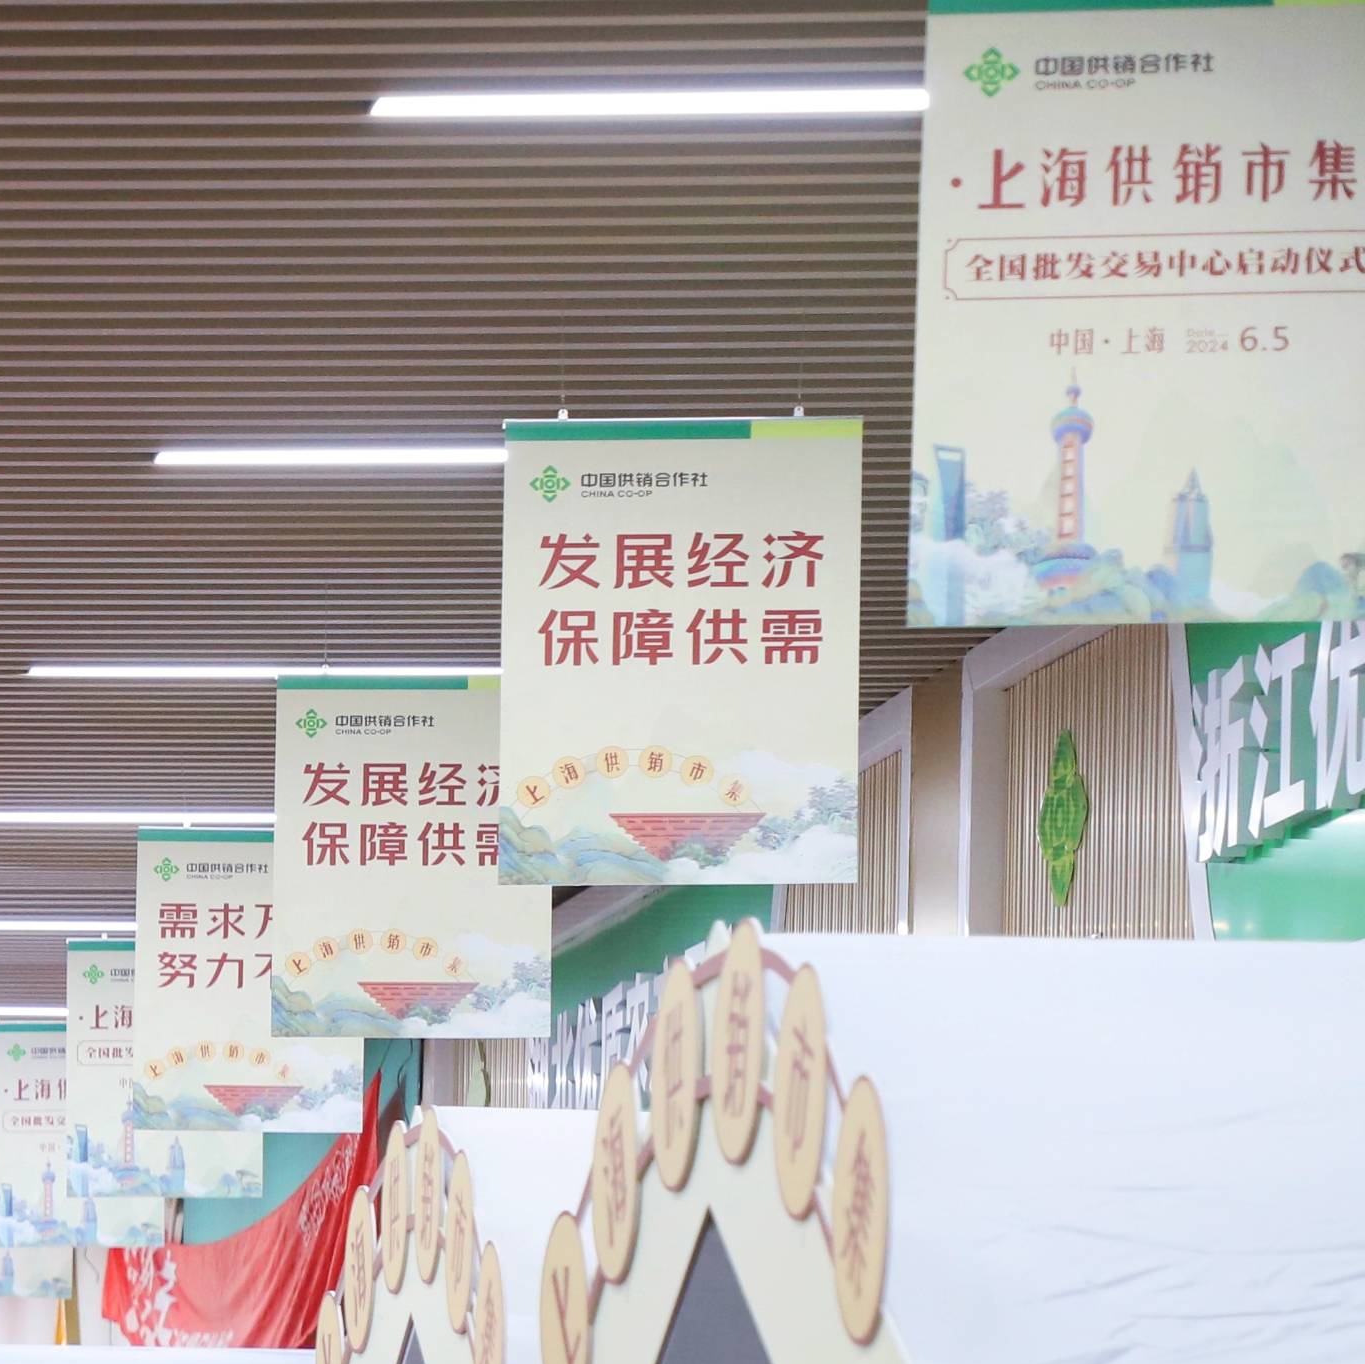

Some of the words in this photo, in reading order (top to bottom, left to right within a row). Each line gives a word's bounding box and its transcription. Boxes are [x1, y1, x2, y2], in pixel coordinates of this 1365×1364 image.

[1035, 51, 1214, 77] 中国供销合作社
[1035, 80, 1082, 91] CHINA
[977, 139, 1358, 210] 上海供销市集
[965, 247, 1365, 284] 全国批发交易中心启动仪式
[1186, 340, 1229, 354] 2024
[1240, 325, 1290, 353] 6.5
[581, 471, 708, 489] 中国供销合作社
[538, 531, 824, 590] 发展经济
[537, 608, 823, 667] 保障供需
[335, 714, 435, 729] 中国供销合作社
